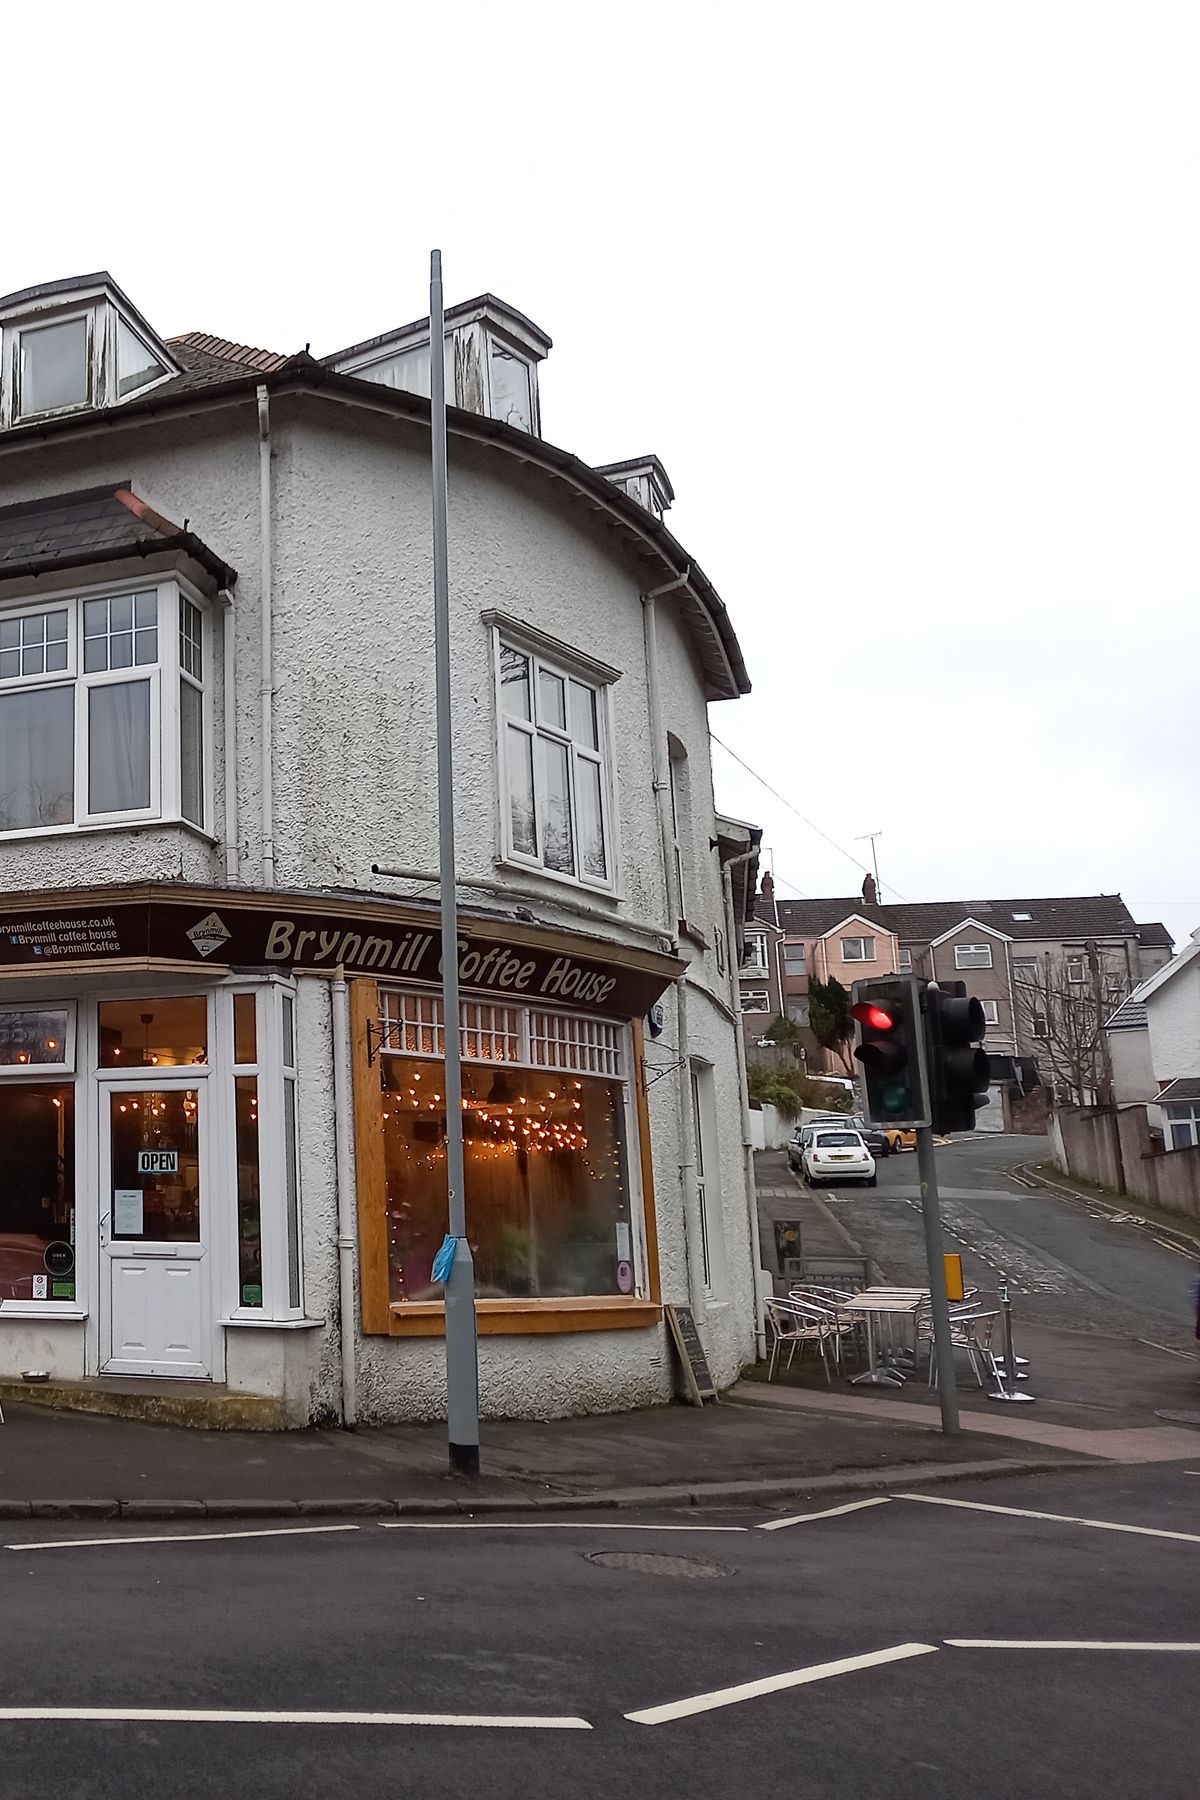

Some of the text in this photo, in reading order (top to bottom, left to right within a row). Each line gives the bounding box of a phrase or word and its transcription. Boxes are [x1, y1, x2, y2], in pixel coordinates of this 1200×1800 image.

[18, 929, 118, 945] Brynmill coffee house
[43, 941, 121, 956] @BrynmillCoffee
[265, 920, 433, 972] Brynmill
[540, 957, 618, 1003] House
[141, 1153, 176, 1171] OPEN
